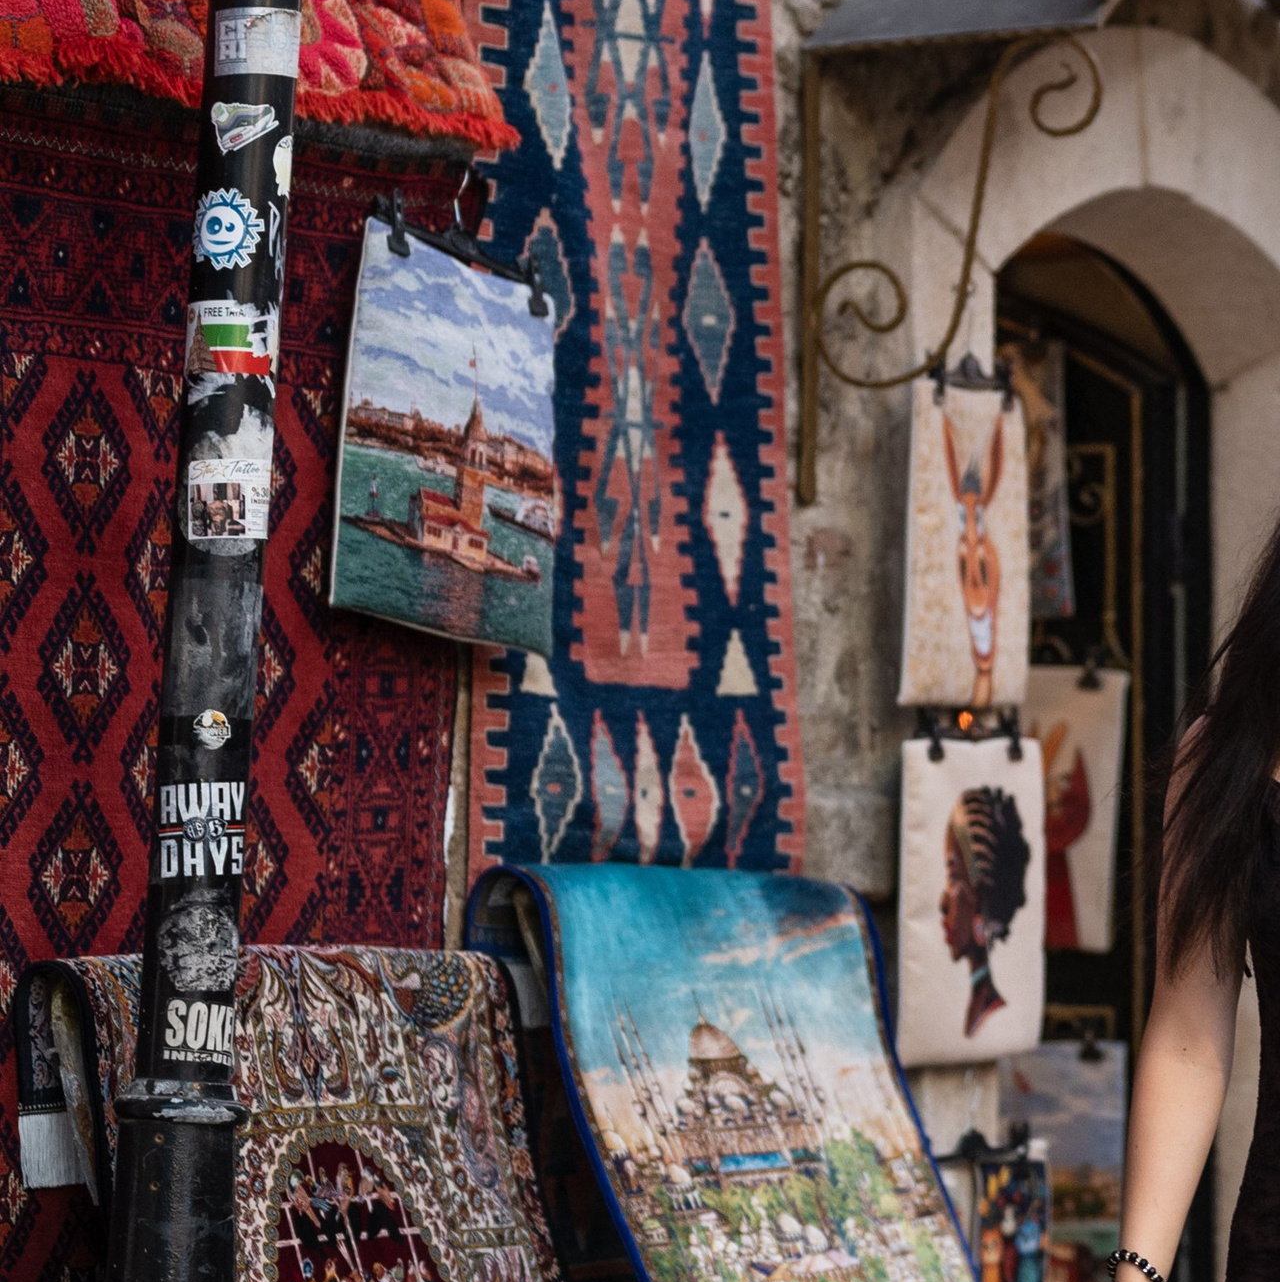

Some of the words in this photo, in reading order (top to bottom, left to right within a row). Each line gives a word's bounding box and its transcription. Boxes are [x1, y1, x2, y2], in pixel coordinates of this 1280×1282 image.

[203, 307, 223, 317] FREE
[160, 782, 245, 824] AWAY
[161, 836, 244, 879] DAYS
